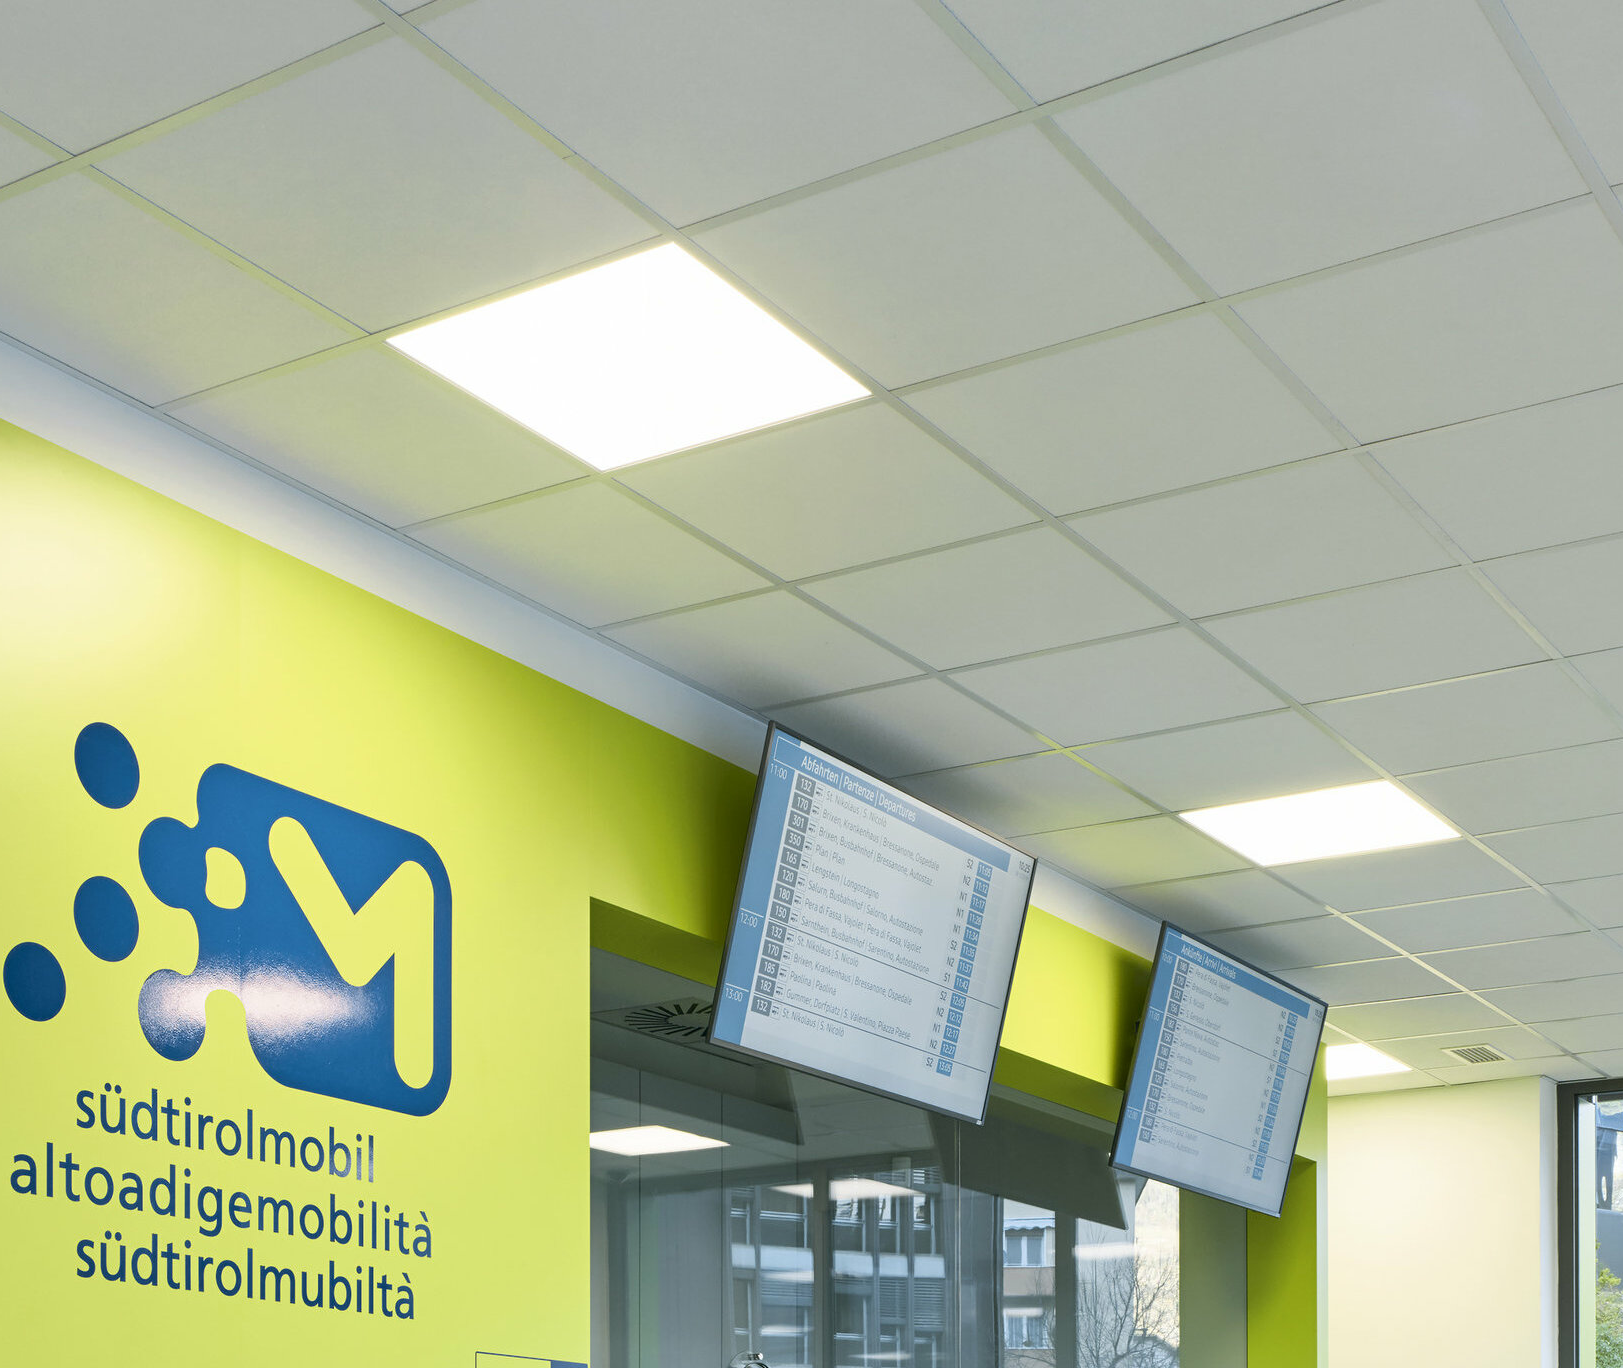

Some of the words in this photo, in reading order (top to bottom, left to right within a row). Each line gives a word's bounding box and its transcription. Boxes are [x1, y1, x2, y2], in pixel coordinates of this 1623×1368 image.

[770, 764, 787, 779] 11:00
[801, 756, 839, 783] Abfahrten
[843, 776, 875, 801] Partenze
[878, 794, 916, 822] Departures
[793, 815, 805, 828] 301
[840, 837, 873, 858] Busbahnhof
[959, 892, 967, 901] N1
[796, 796, 808, 809] 170
[843, 819, 879, 842] Krankenhaus
[915, 853, 939, 872] Ospedale
[963, 875, 970, 885] N2
[800, 778, 812, 791] 132
[834, 795, 860, 814] Nikolaus
[966, 859, 974, 869] S2
[782, 869, 794, 881] 120
[829, 889, 863, 910] Busbahnhof
[889, 915, 923, 935] Autostazione
[949, 940, 957, 949] S2
[785, 851, 797, 864] 165
[843, 876, 879, 901] Longostagno
[953, 924, 960, 934] N1
[789, 833, 801, 845] 350
[815, 845, 830, 858] Plan
[832, 852, 845, 865] Plan
[956, 908, 964, 917] N1
[740, 913, 758, 927] 12:00
[774, 906, 787, 918] 150
[831, 928, 865, 948] Busbahnhof
[895, 954, 929, 973] Autostazione
[943, 973, 950, 982] S1
[778, 888, 790, 900] 180
[804, 898, 818, 911] Pera
[843, 914, 863, 931] Vajolet
[867, 924, 879, 935] Pera
[903, 939, 922, 955] Vajolet
[946, 957, 954, 966] N2
[724, 988, 742, 1001] 13:00
[763, 962, 775, 974] 185
[933, 1023, 940, 1032] N1
[767, 944, 779, 956] 170
[814, 962, 851, 982] Krankenhaus
[887, 989, 912, 1006] Ospedale
[936, 1007, 943, 1016] N2
[770, 926, 783, 938] 132
[805, 939, 831, 956] Nikolaus
[939, 991, 947, 1000] S2
[1204, 956, 1218, 970] Arrivi
[756, 1000, 768, 1011] 132
[791, 1011, 817, 1027] Nikolaus
[926, 1056, 933, 1065] S2
[760, 980, 772, 992] 182
[878, 1021, 895, 1033] Piazza
[895, 1027, 911, 1039] Paese
[929, 1039, 937, 1048] N2
[76, 1082, 374, 1183] südtirolmobil
[10, 1142, 432, 1258] altoadigemobilità
[76, 1230, 415, 1320] südtirolmubiltà
